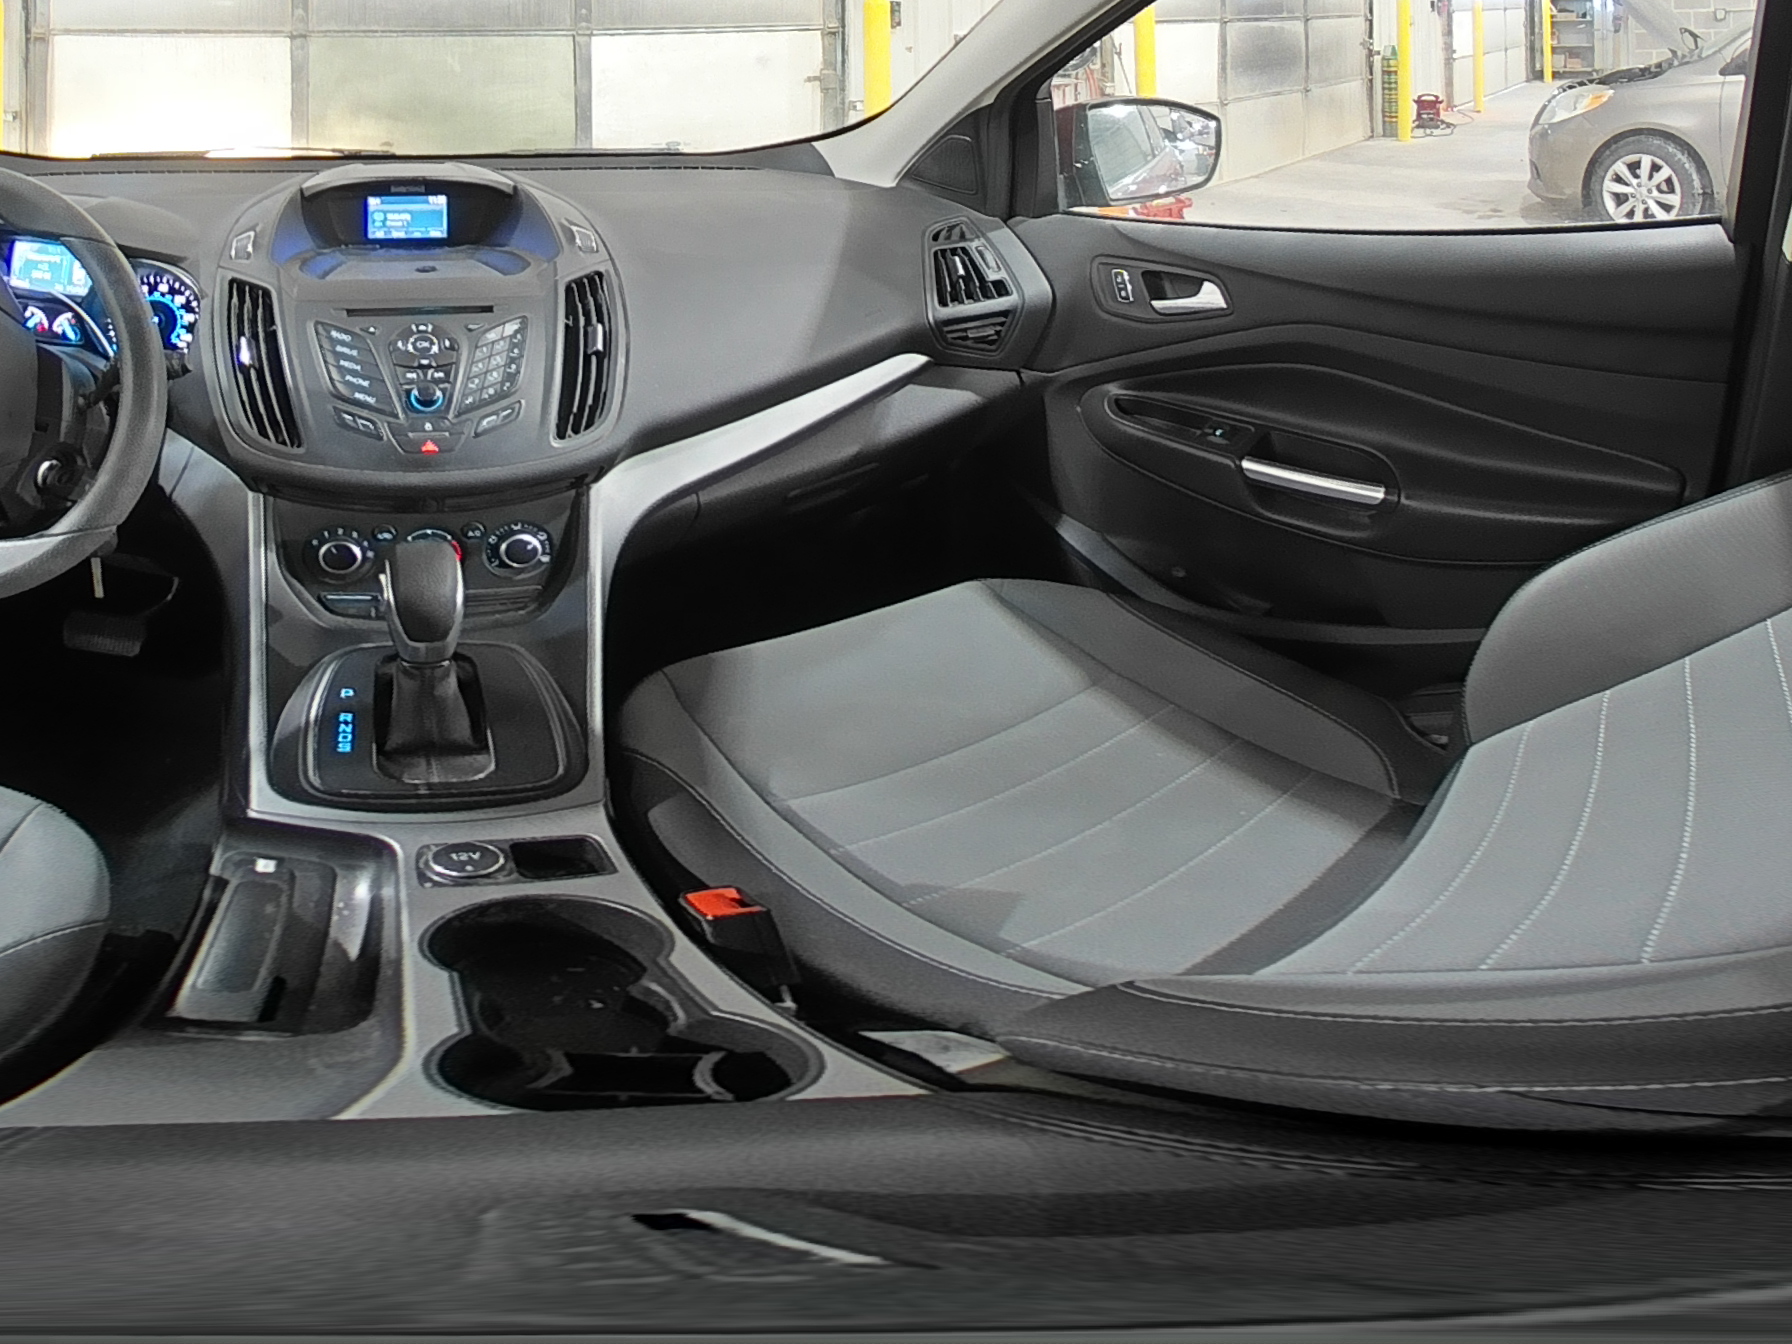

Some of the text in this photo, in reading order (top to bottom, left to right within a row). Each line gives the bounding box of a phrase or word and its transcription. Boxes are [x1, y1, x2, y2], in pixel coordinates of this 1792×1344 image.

[330, 330, 352, 342] RADIO
[344, 374, 370, 388] PHONE
[340, 688, 355, 699] P
